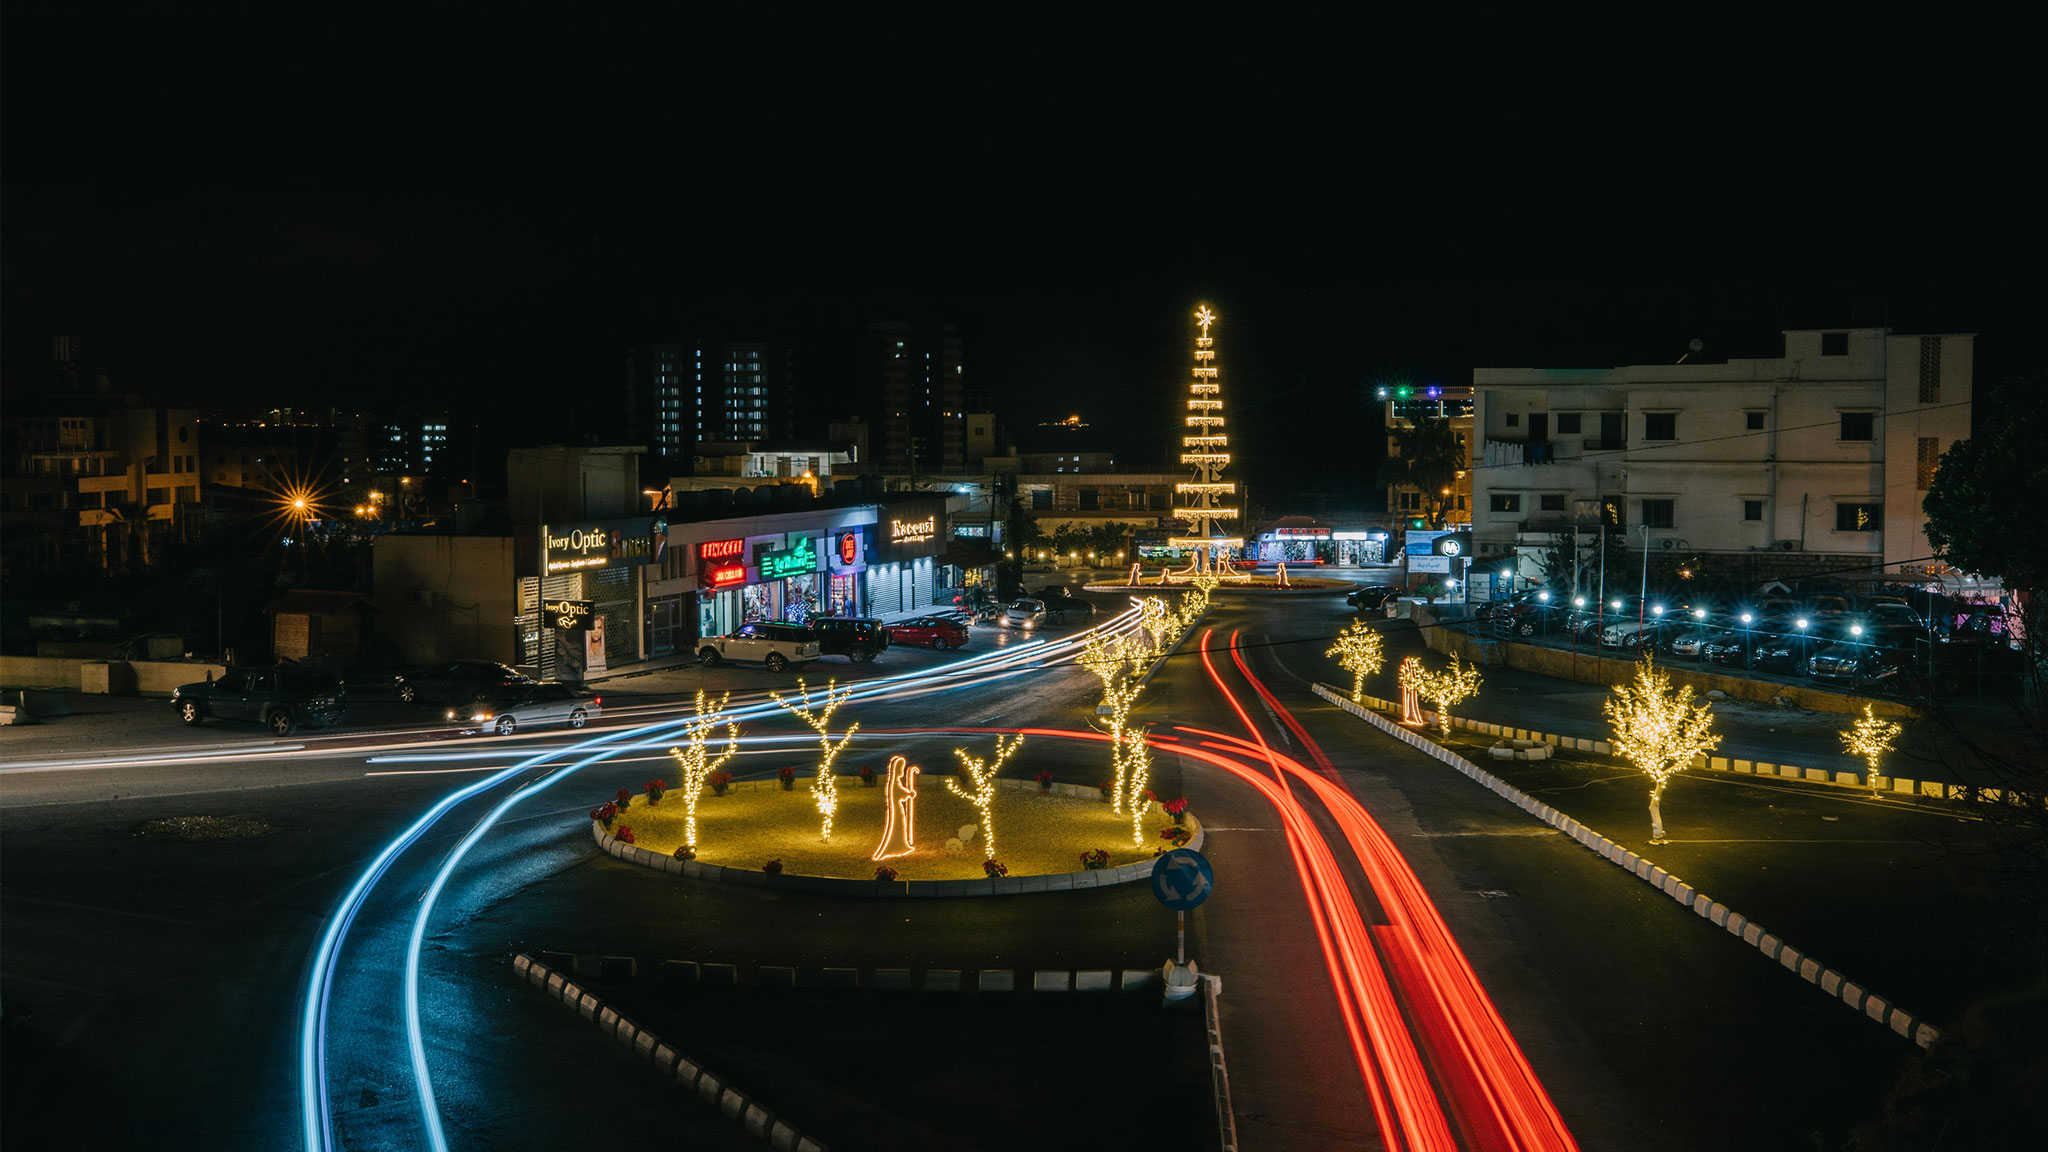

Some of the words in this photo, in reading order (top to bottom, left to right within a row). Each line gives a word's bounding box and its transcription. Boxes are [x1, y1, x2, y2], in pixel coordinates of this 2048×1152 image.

[548, 535, 570, 551] Ivory
[571, 527, 606, 555] Optic
[545, 603, 560, 613] Ivory
[560, 601, 589, 618] Optic
